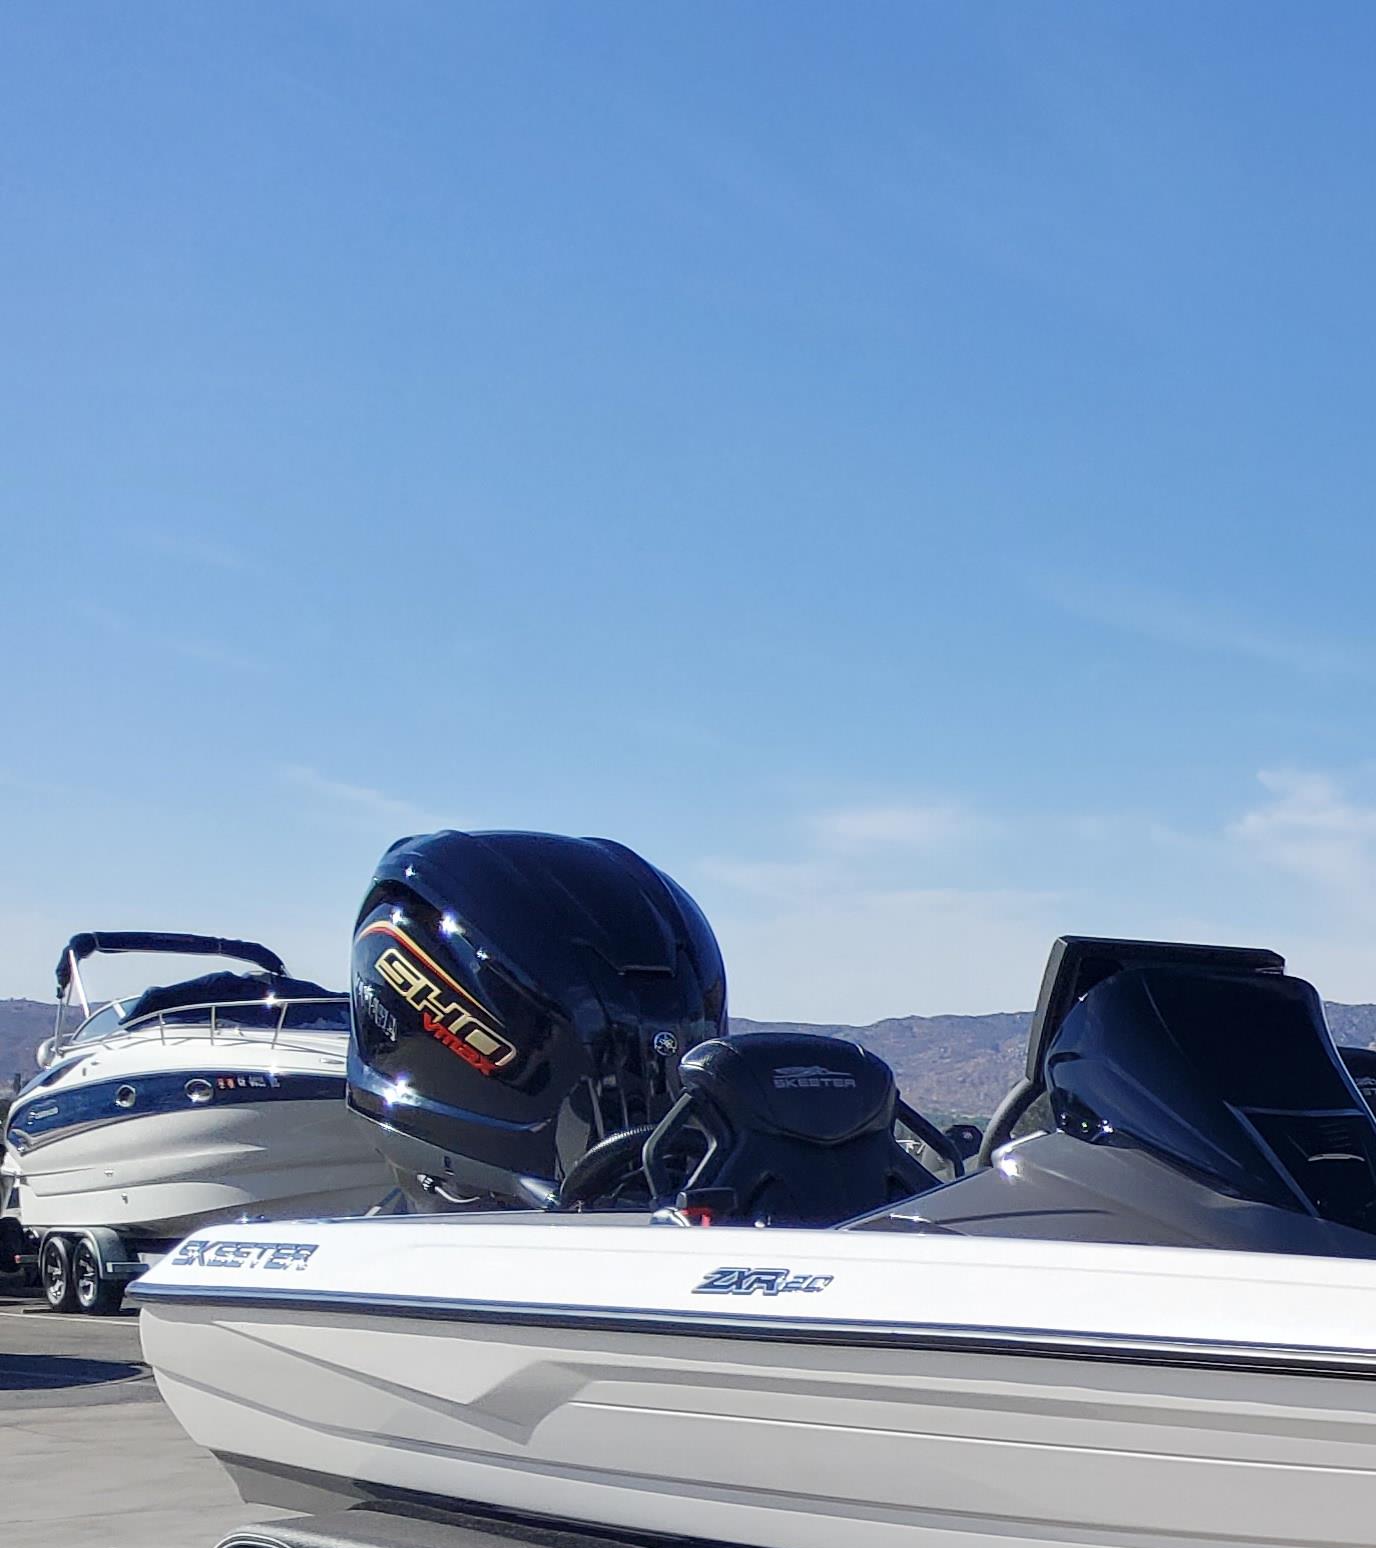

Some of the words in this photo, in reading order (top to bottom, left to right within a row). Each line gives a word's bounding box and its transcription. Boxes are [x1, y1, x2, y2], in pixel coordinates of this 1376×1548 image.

[375, 949, 517, 1066] SHO
[773, 1078, 856, 1089] SKEETER
[172, 1240, 320, 1271] SKEETER
